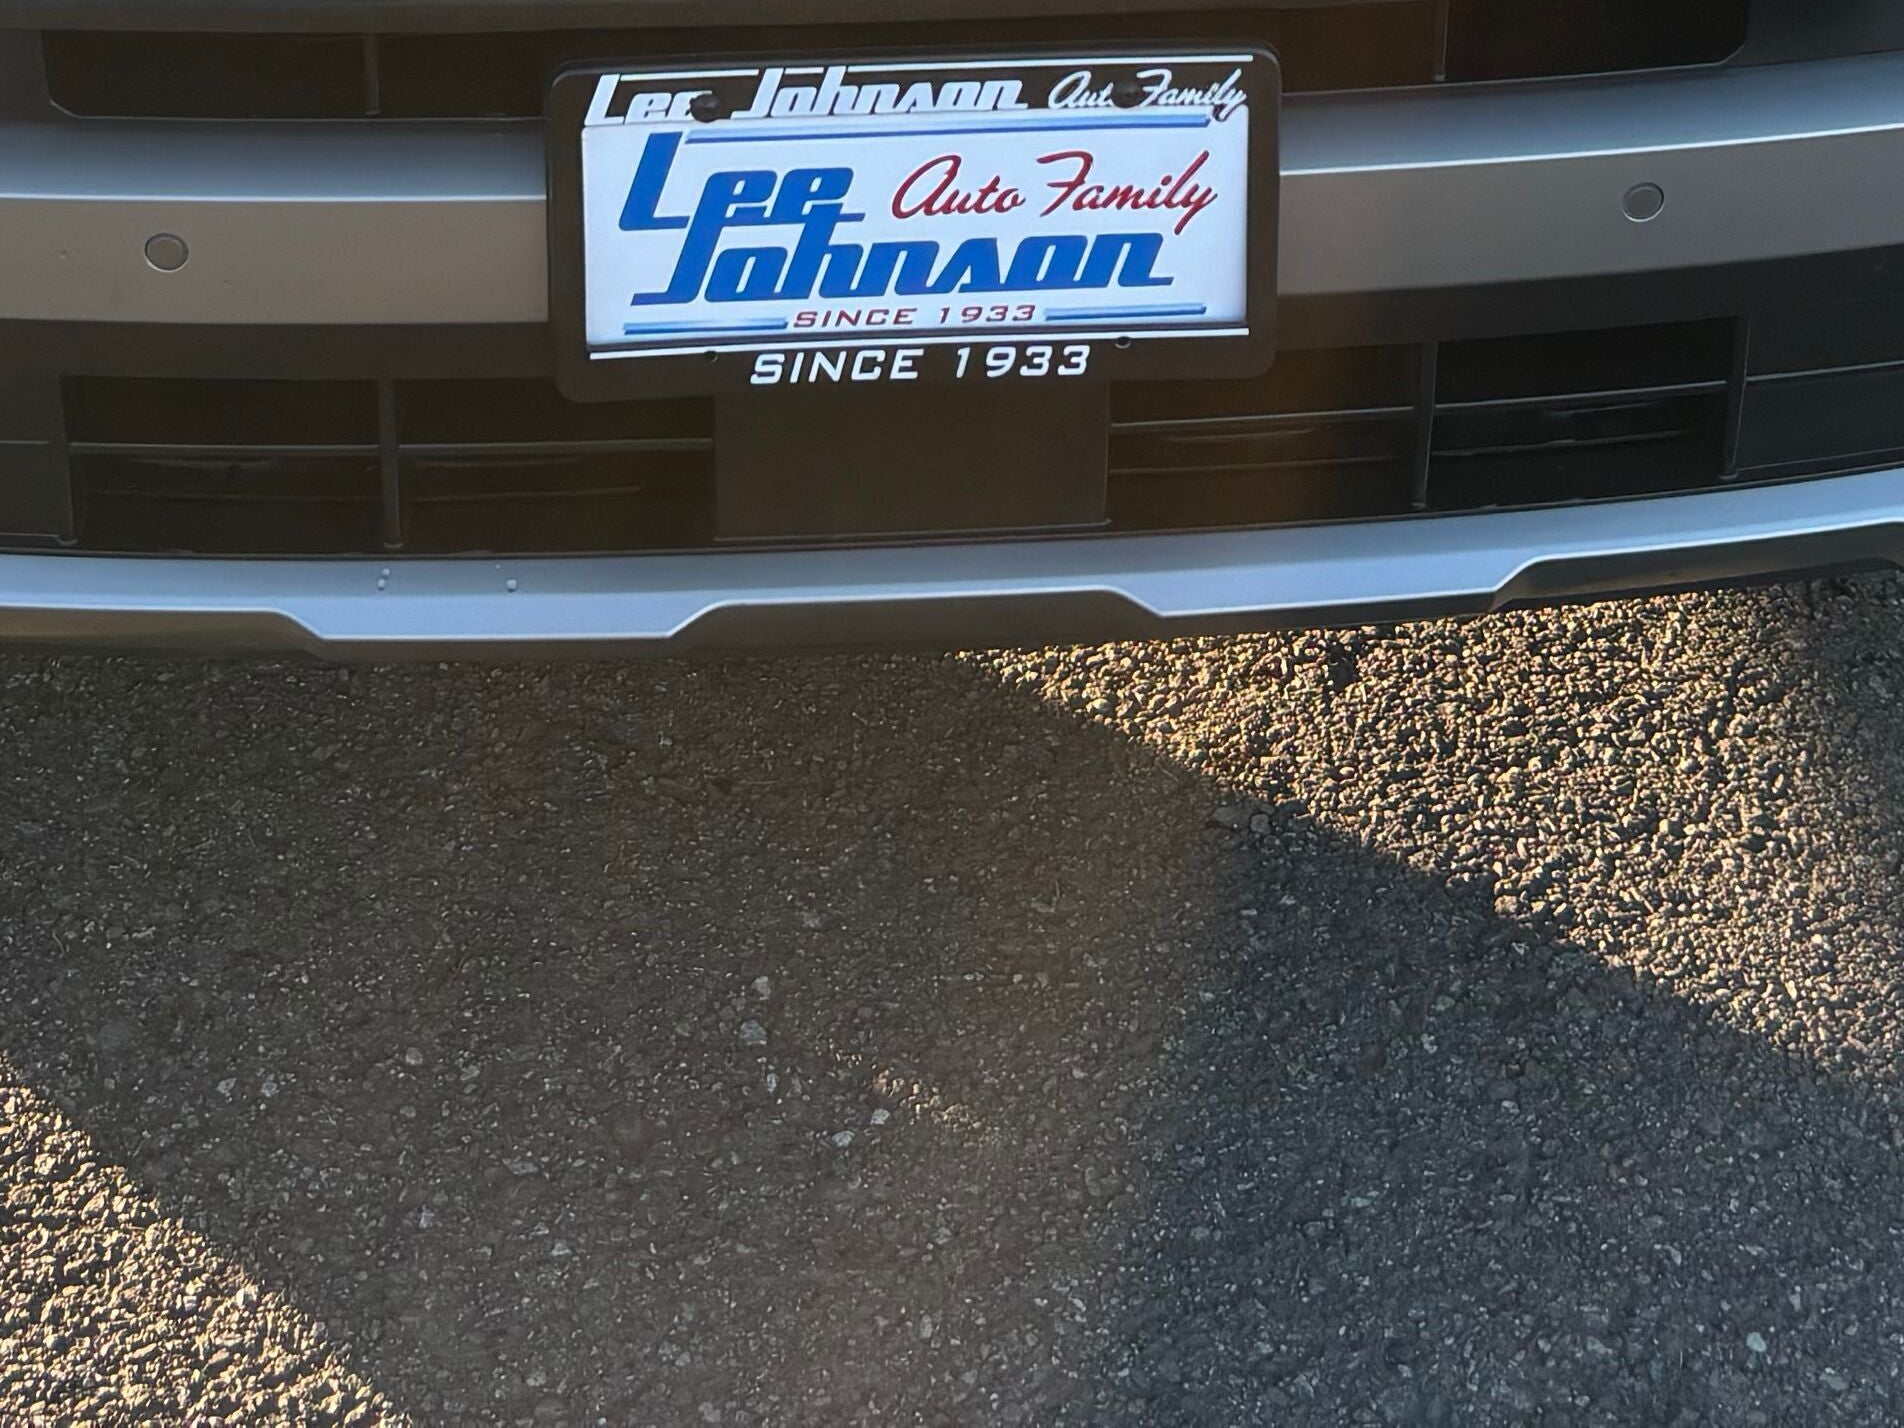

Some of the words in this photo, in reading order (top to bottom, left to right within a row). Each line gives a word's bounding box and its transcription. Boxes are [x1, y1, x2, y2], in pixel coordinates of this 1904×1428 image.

[731, 66, 1029, 120] Johnson
[1136, 68, 1247, 122] Family
[619, 131, 865, 231] Lee
[892, 154, 1026, 219] Auto
[1036, 149, 1218, 235] Family
[631, 206, 1174, 306] Johnson
[793, 307, 918, 329] SINCE
[939, 304, 1036, 324] 1933
[749, 348, 924, 385] SINCE
[956, 344, 1091, 379] 1933
